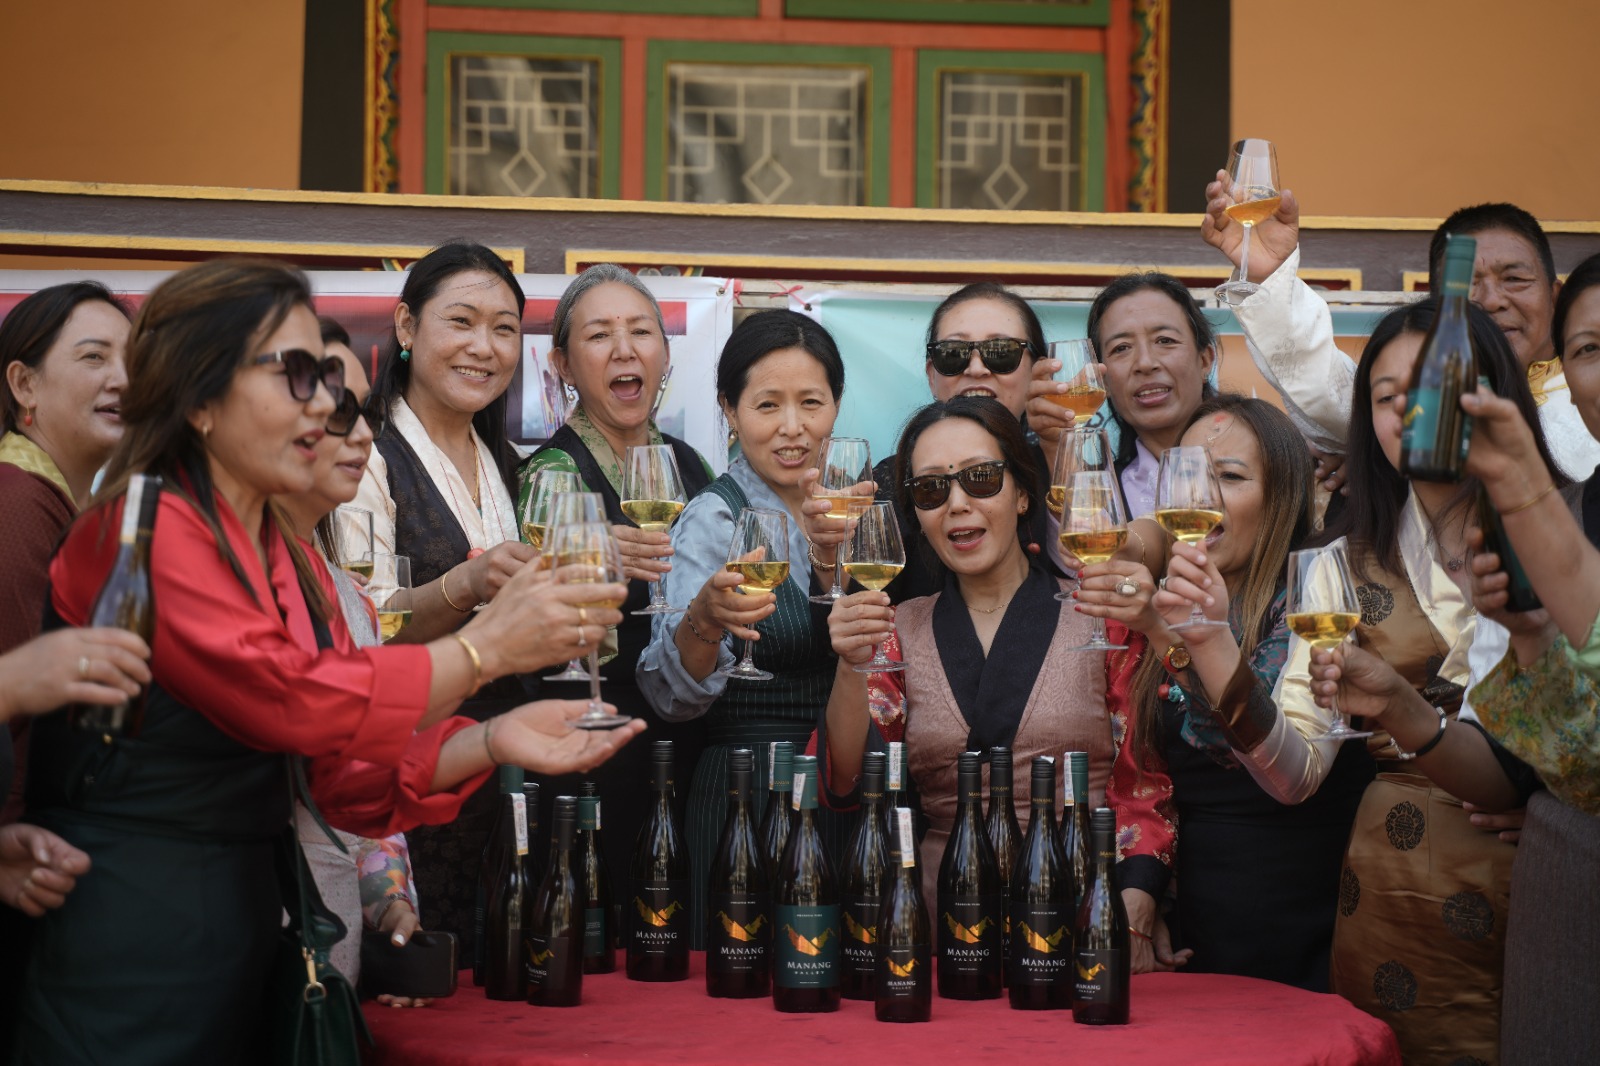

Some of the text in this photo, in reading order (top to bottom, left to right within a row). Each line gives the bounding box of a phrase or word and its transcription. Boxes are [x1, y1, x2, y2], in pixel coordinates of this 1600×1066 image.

[635, 930, 677, 939] MANANG
[720, 946, 764, 955] MANANG
[844, 948, 873, 957] MANA
[946, 947, 990, 956] MANANG
[787, 961, 831, 970] MANANG
[1021, 957, 1066, 967] MANANG
